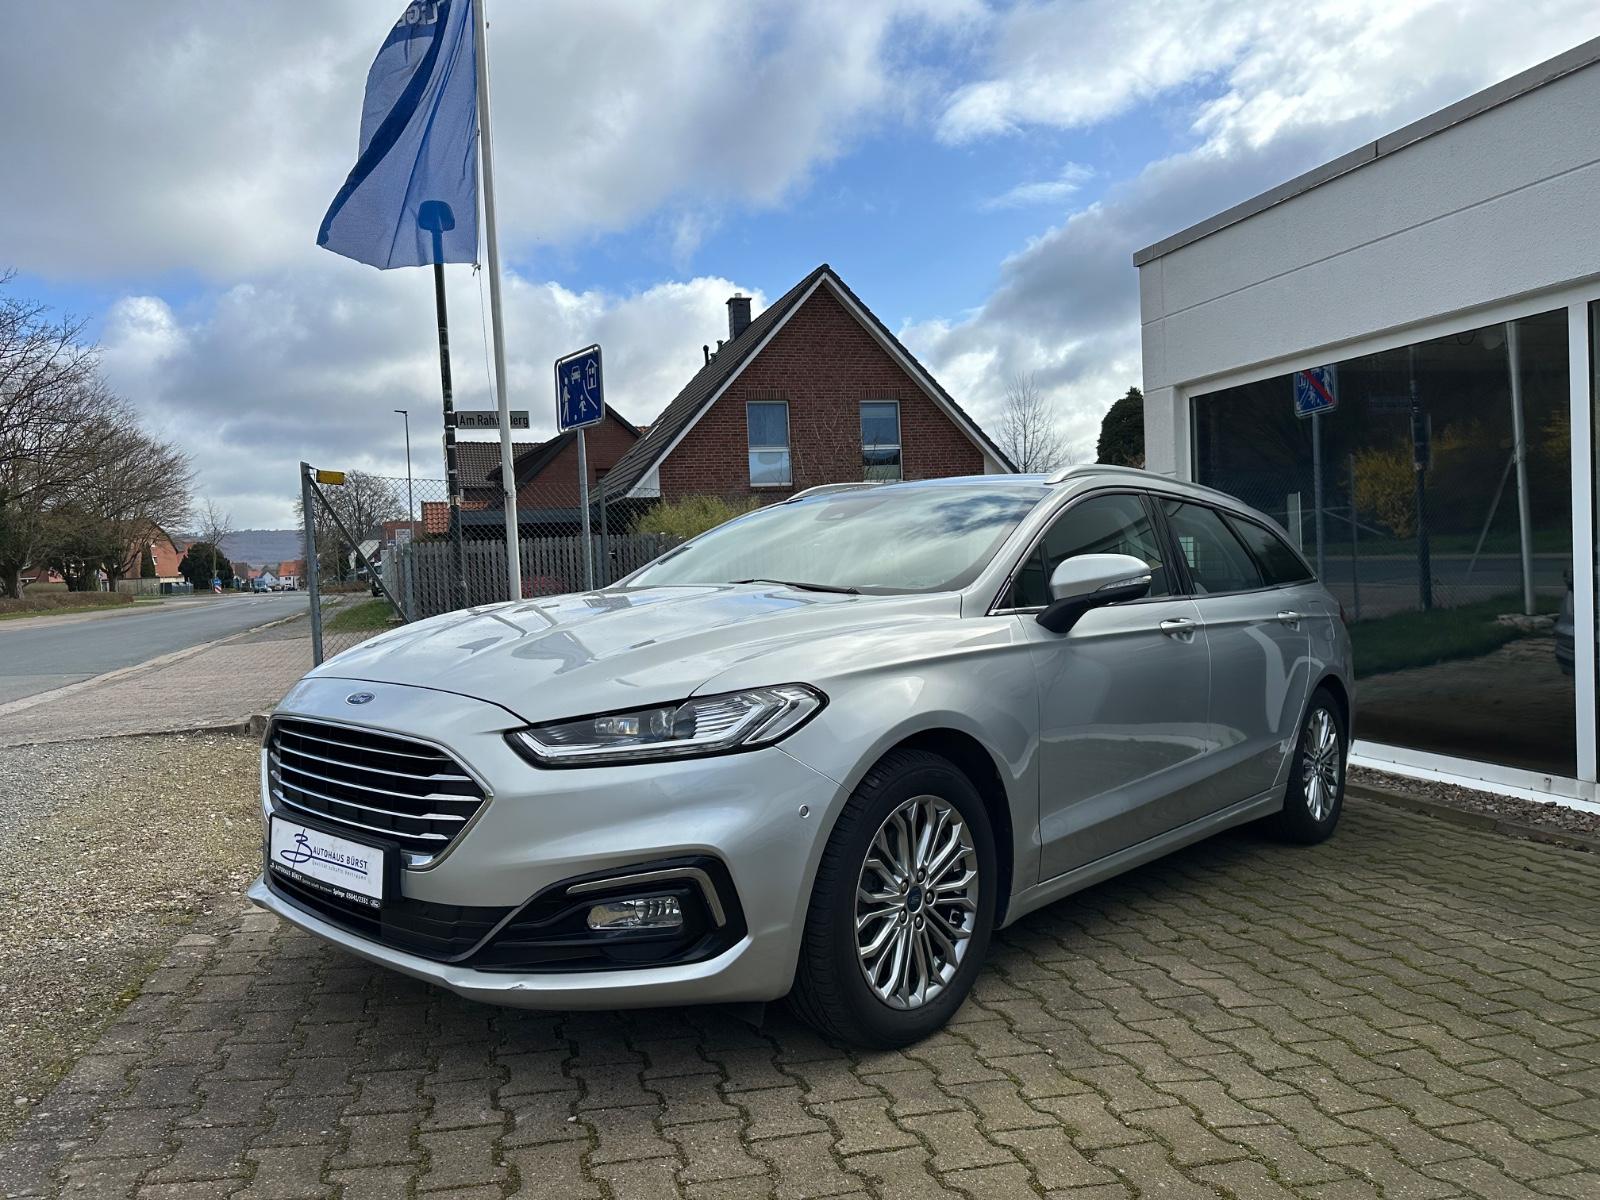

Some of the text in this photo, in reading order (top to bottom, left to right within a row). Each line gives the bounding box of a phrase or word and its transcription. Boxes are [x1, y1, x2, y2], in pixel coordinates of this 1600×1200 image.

[460, 414, 475, 426] Am
[312, 846, 345, 863] AUTOHAUS
[346, 855, 368, 870] BÜRST
